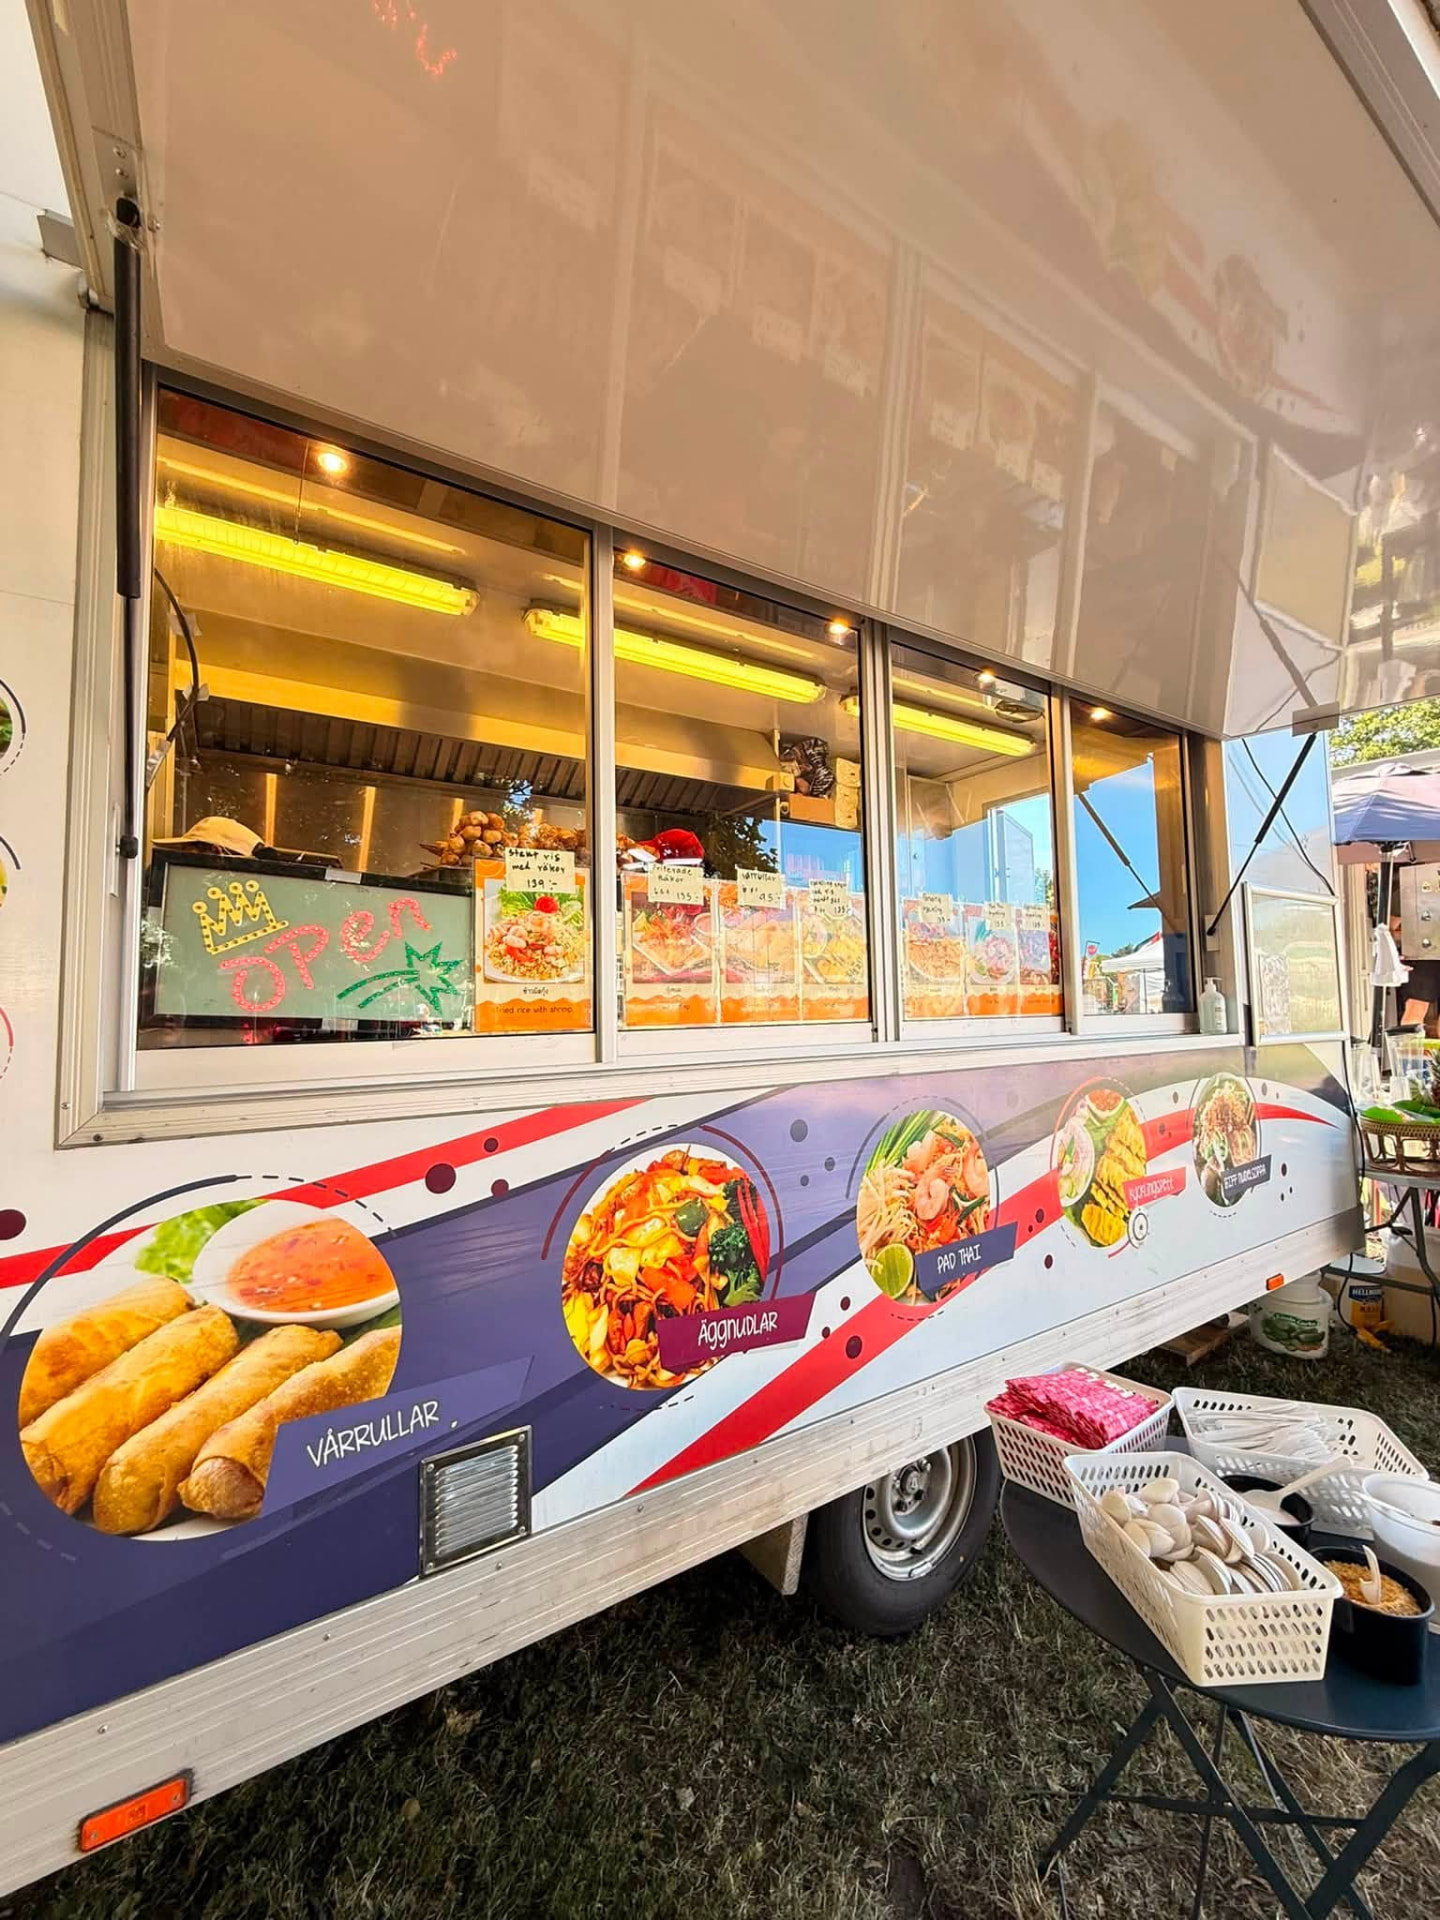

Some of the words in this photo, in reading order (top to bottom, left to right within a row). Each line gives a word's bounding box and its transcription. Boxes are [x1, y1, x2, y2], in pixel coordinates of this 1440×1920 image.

[511, 860, 531, 871] med
[533, 1006, 548, 1014] with
[937, 1252, 957, 1275] PAD
[958, 1243, 982, 1266] THAI
[306, 1400, 440, 1468] VÅRRULLAR
